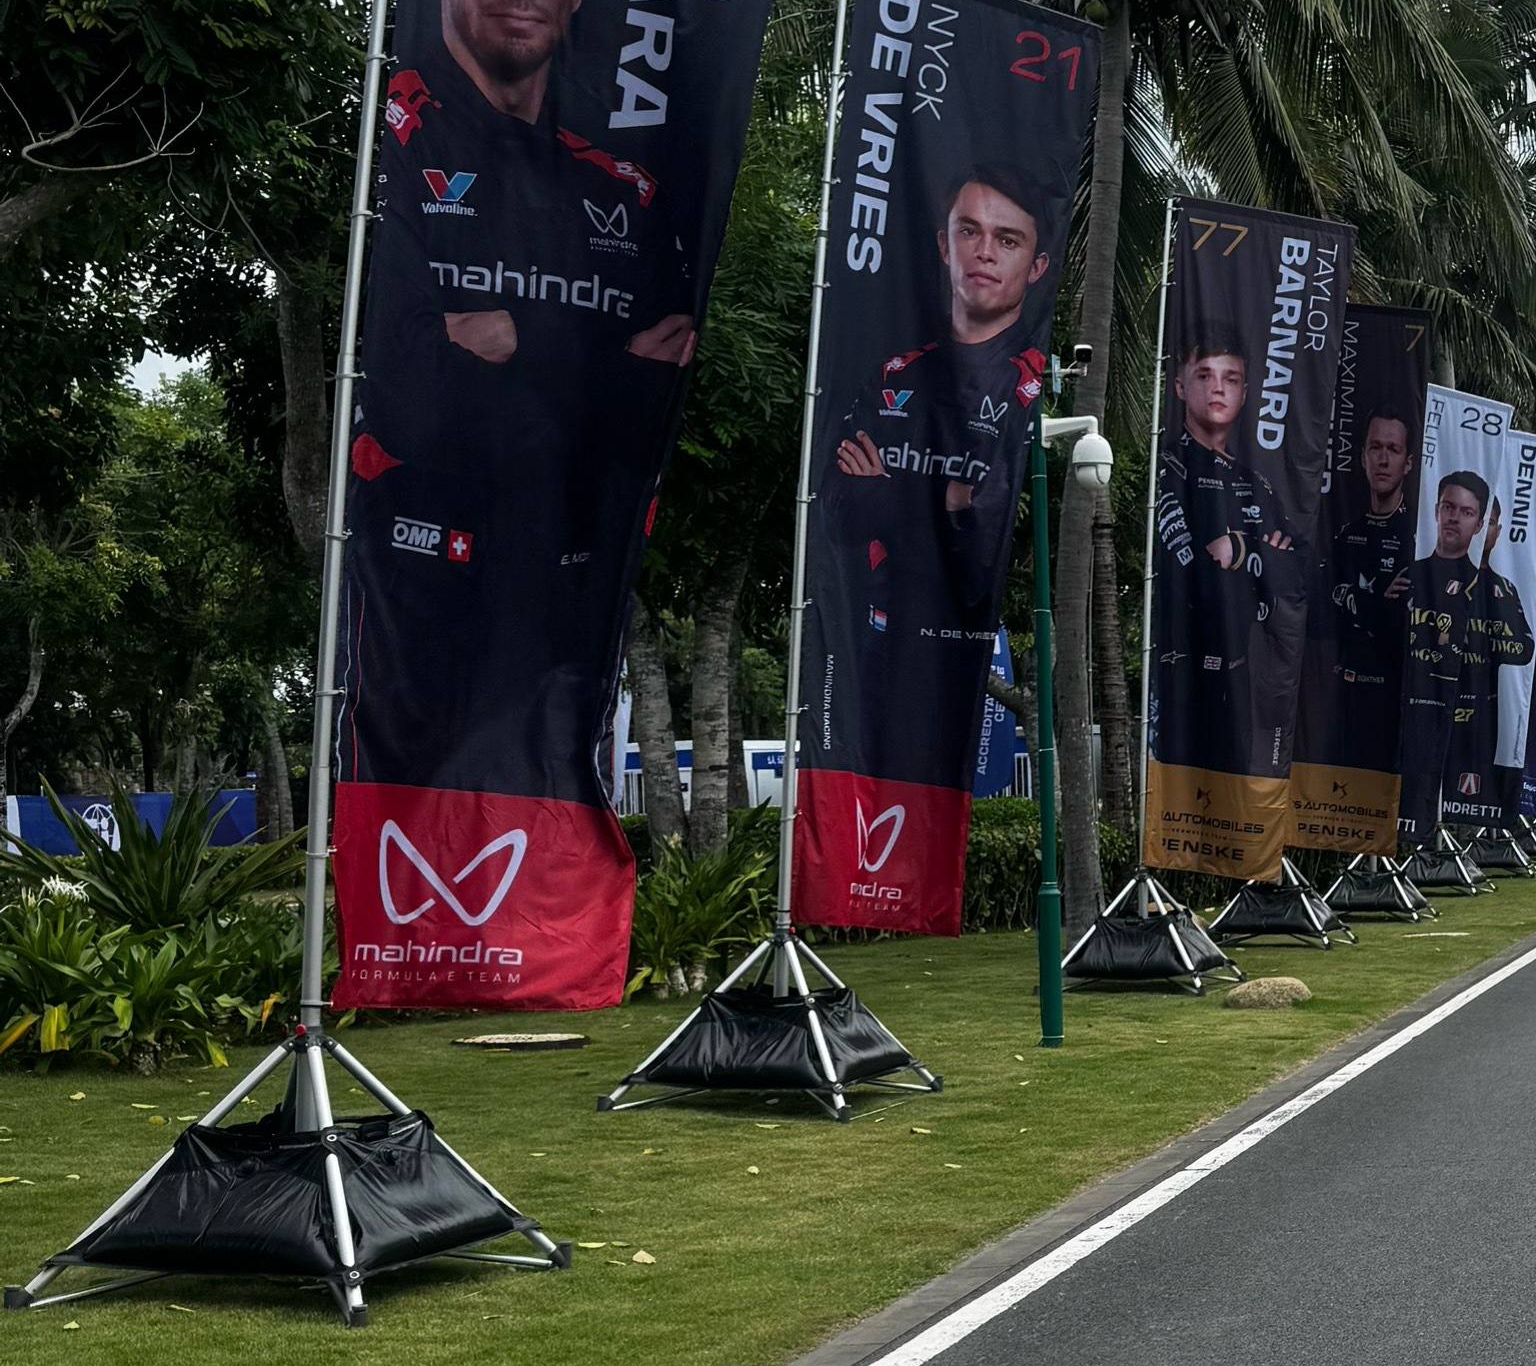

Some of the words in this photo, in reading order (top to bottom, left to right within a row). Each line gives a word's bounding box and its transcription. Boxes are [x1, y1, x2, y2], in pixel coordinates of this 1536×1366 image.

[911, 2, 960, 122] NYCK
[1010, 30, 1083, 91] 21
[846, 91, 904, 275] VRIES
[1189, 217, 1249, 256] 77
[1303, 244, 1338, 352] TAYLOR
[1256, 237, 1311, 451] BARNARD
[1405, 324, 1425, 352] 7
[1336, 320, 1360, 472] MAXIMILIAN
[1461, 407, 1503, 436] 28
[879, 442, 991, 482] ahindr
[1509, 444, 1536, 543] DENNIS
[392, 522, 441, 550] OMP
[823, 711, 831, 750] RACING
[976, 694, 995, 775] ACCREDITA
[1454, 708, 1475, 722] 27
[1163, 811, 1265, 834] AUTOMOBILES
[1304, 803, 1388, 819] AUTOMOBILES
[1443, 801, 1502, 818] NDRETTI
[354, 940, 523, 965] mahindra
[468, 971, 521, 983] TEAM
